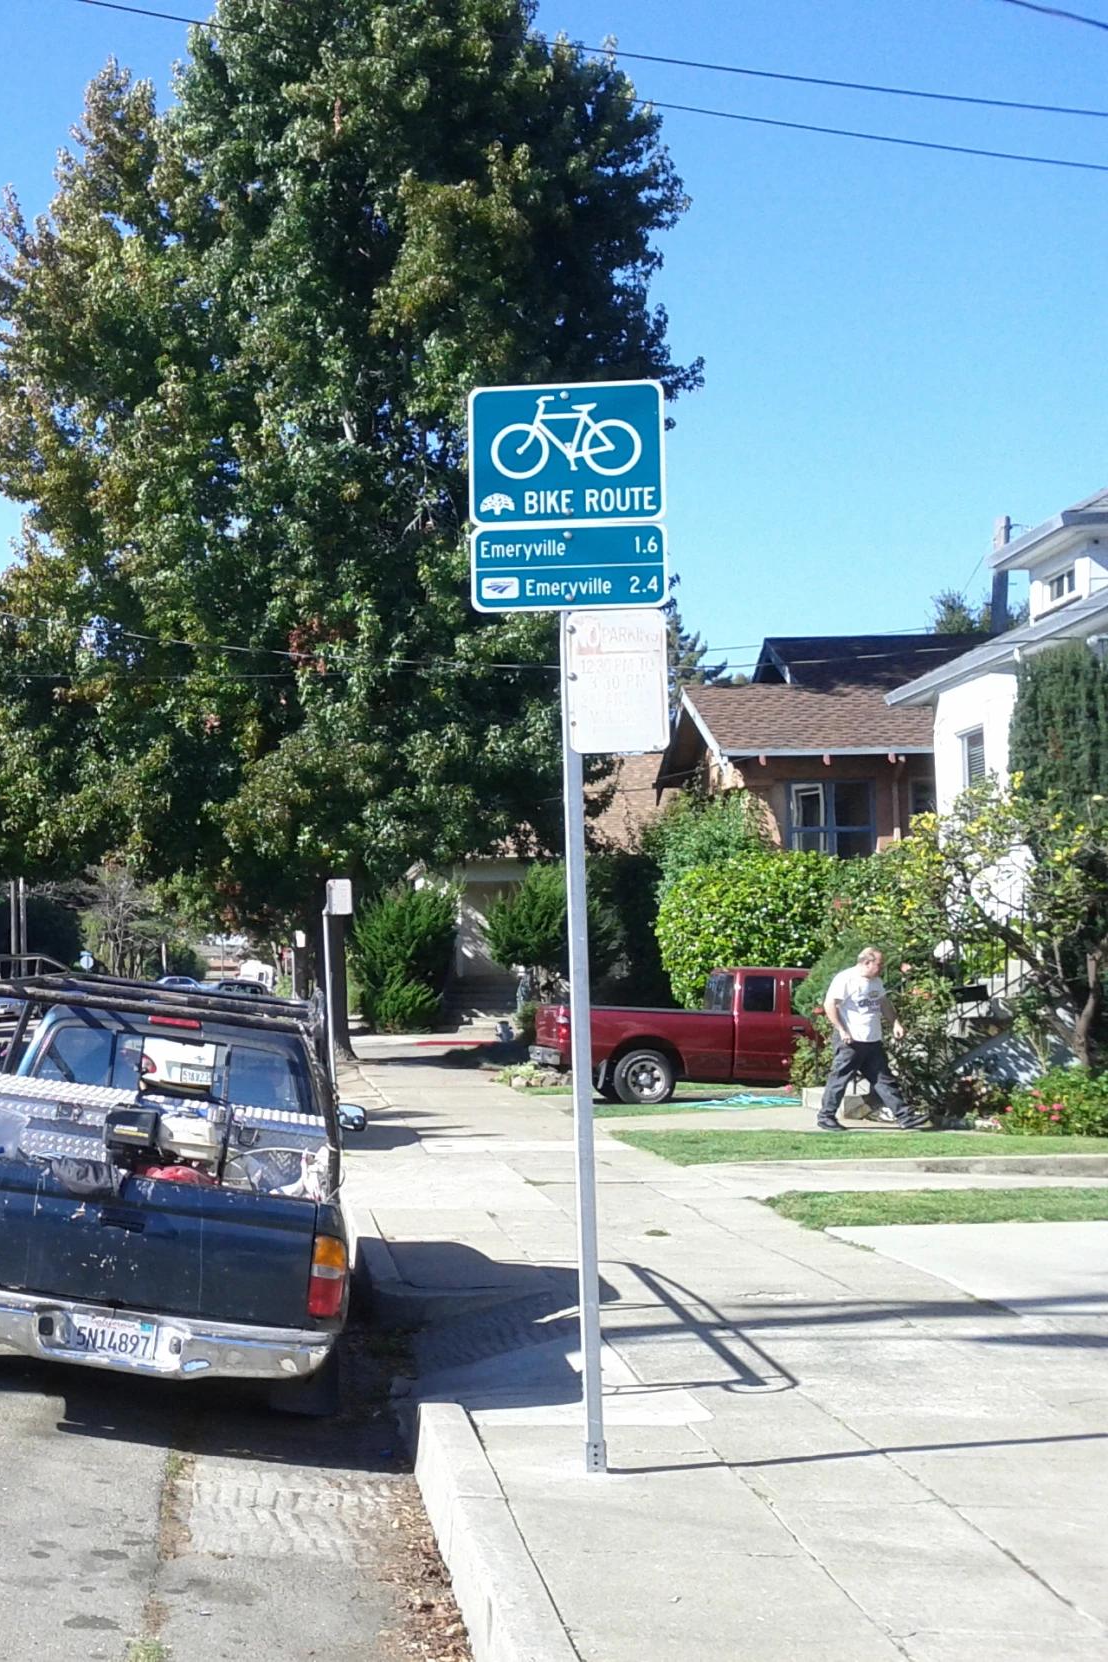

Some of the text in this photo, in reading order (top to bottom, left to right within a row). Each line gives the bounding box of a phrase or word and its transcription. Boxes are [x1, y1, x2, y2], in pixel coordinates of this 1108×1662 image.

[524, 486, 657, 515] BIKE ROUTE
[480, 536, 658, 561] Emeryville 1.6
[525, 576, 658, 598] Emeryville 2.4
[76, 1325, 150, 1357] 5N14897
